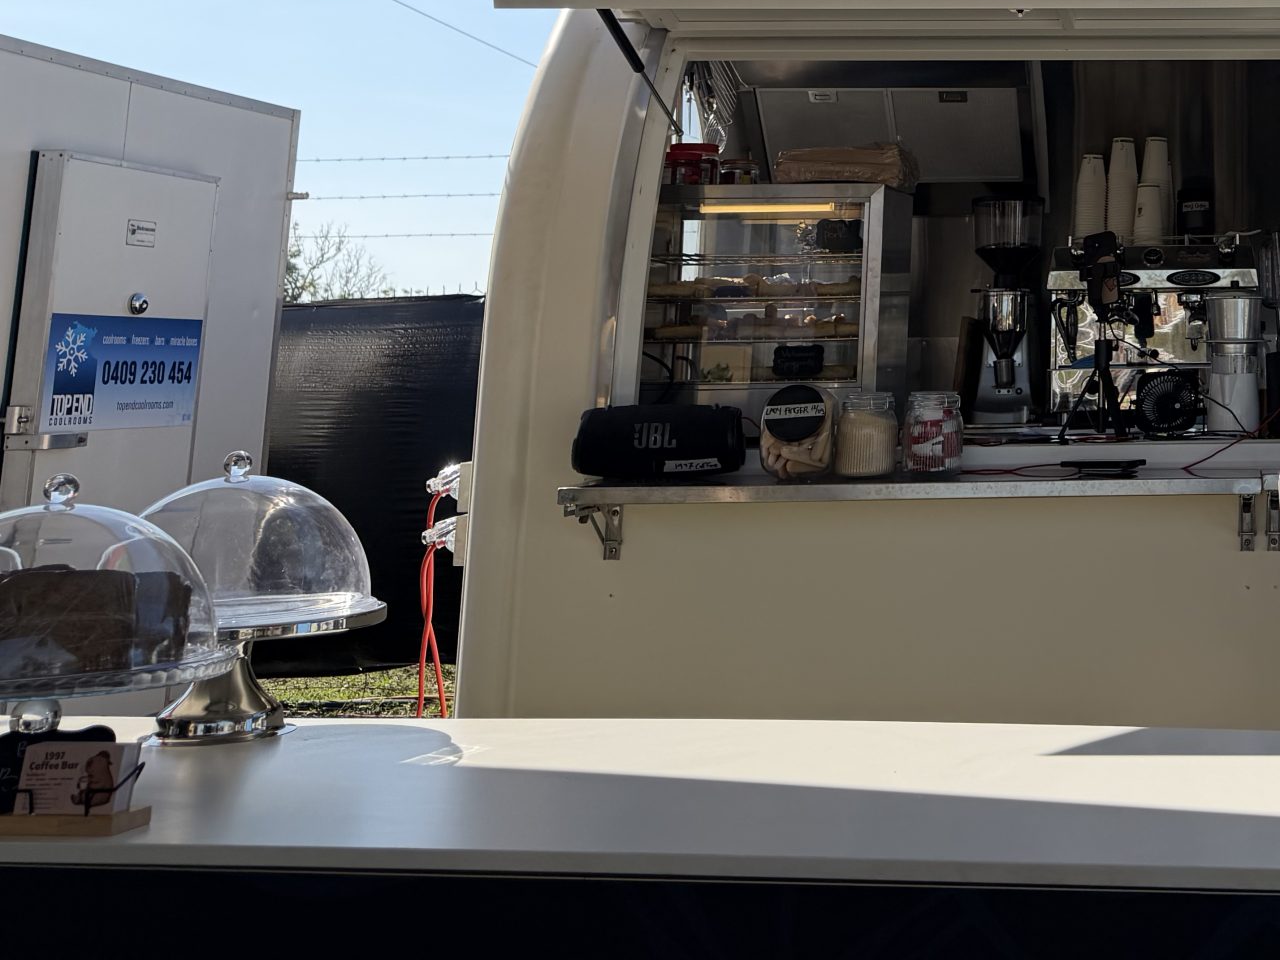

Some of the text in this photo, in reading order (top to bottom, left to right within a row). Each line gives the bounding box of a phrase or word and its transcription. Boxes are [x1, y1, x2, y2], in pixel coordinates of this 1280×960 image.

[102, 334, 127, 346] coolrooms
[131, 334, 150, 346] freezers
[154, 335, 166, 346] bars
[102, 360, 193, 385] 0409 230 454
[52, 393, 94, 417] TOP END
[116, 399, 174, 411] topendcoolrooms.com
[48, 416, 93, 427] COOLROOMS
[633, 422, 677, 449] JBL
[44, 751, 66, 761] 1997
[29, 761, 80, 771] Coffee Bar
